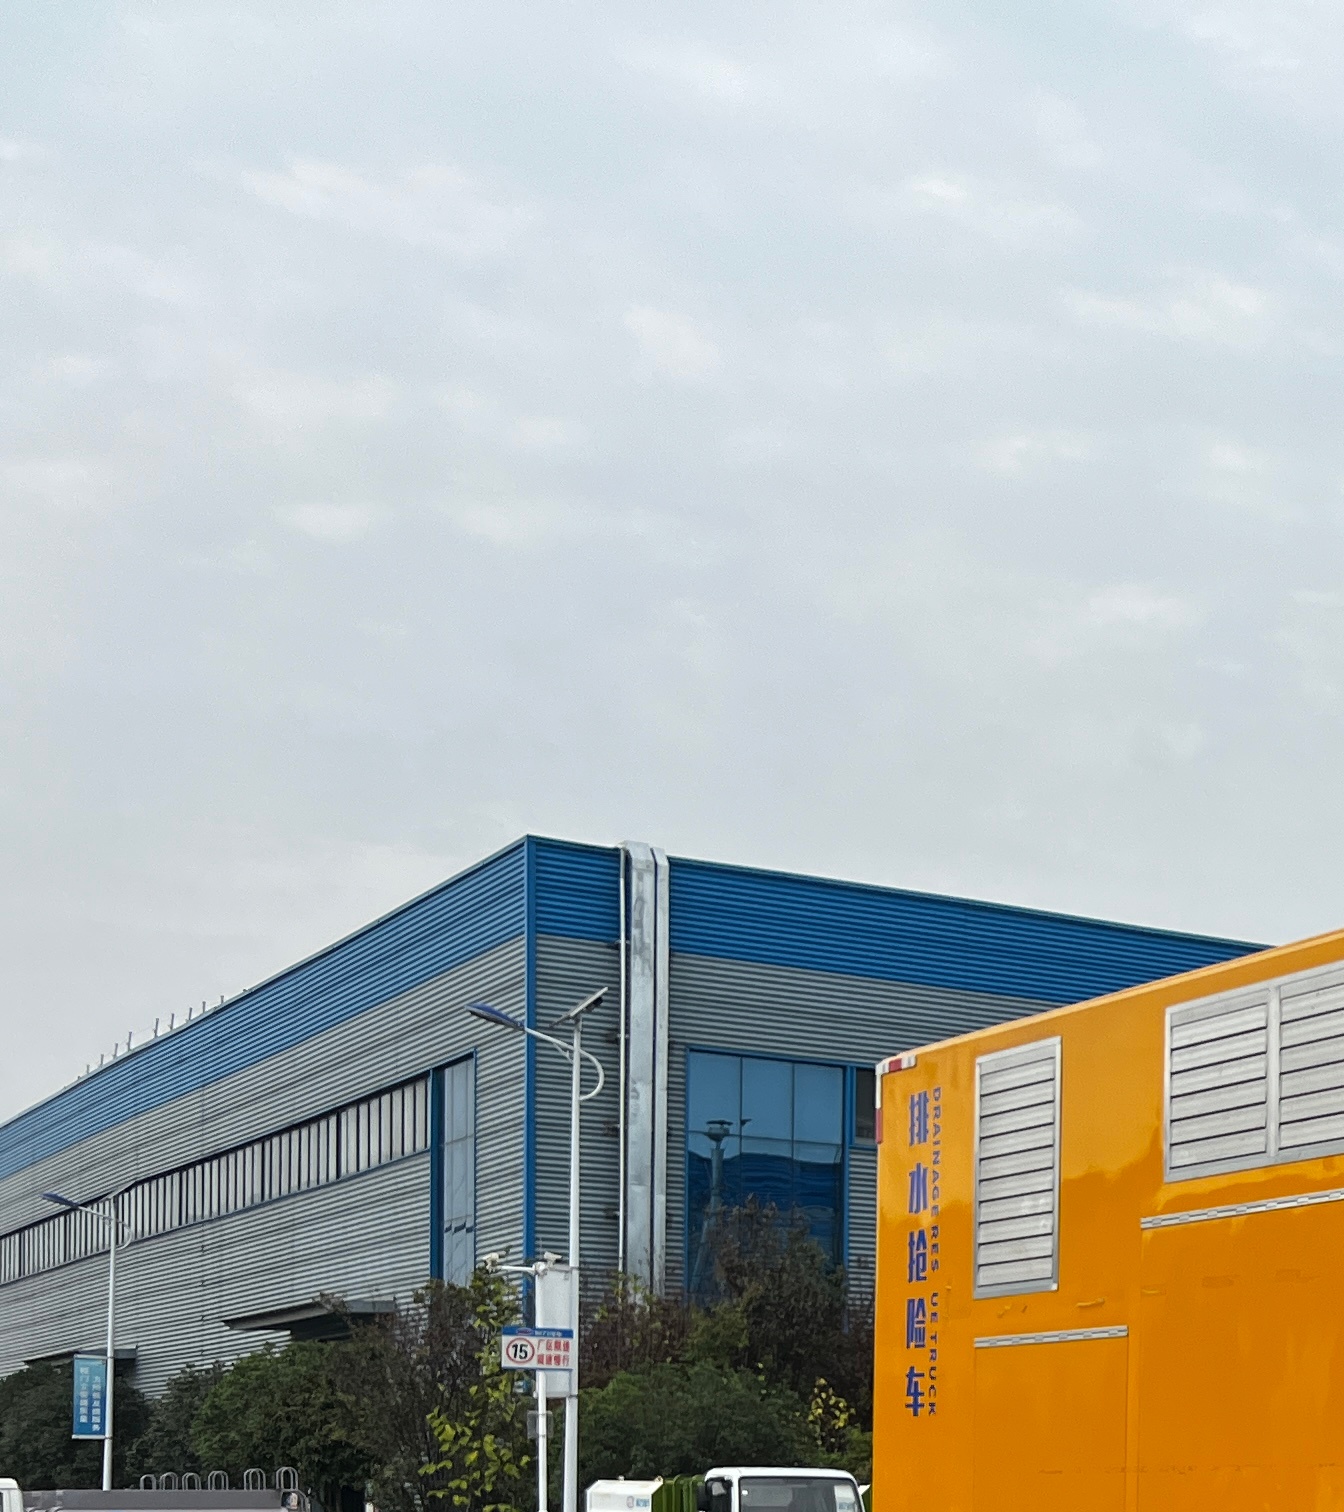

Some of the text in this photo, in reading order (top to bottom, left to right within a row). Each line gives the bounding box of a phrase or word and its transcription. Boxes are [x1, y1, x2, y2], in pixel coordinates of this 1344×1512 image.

[931, 1086, 942, 1217] DRAINAGE
[905, 1091, 930, 1418] 排水抢险车
[511, 1343, 529, 1360] 15
